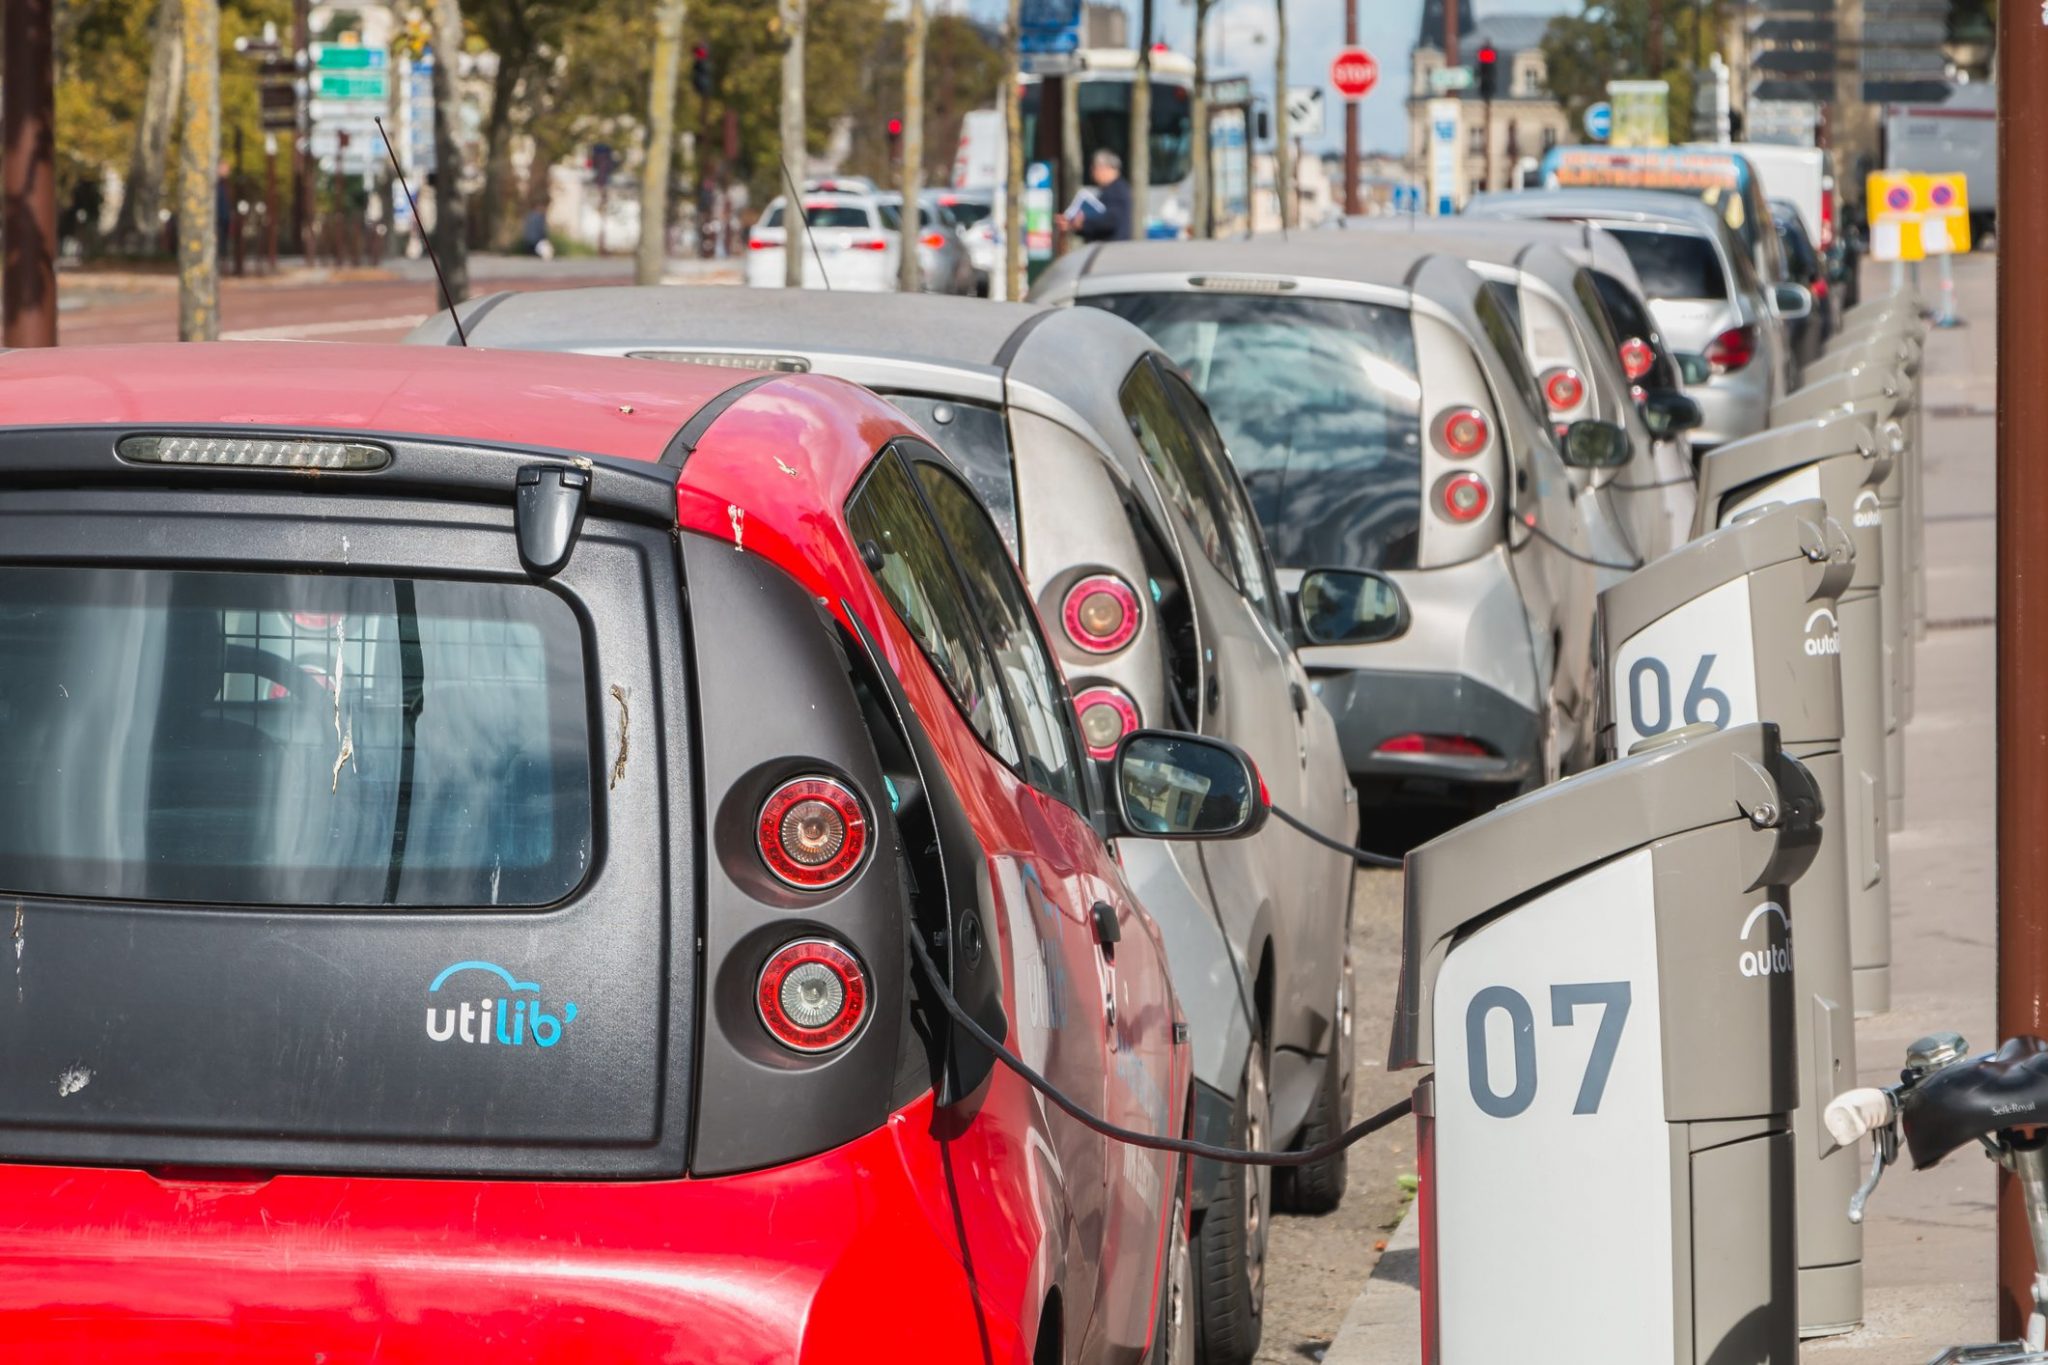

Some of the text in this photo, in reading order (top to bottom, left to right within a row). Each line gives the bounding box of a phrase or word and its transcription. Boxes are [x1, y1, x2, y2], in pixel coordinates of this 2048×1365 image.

[1334, 63, 1377, 82] STOP
[1629, 654, 1731, 738] 06
[1466, 981, 1632, 1118] 07
